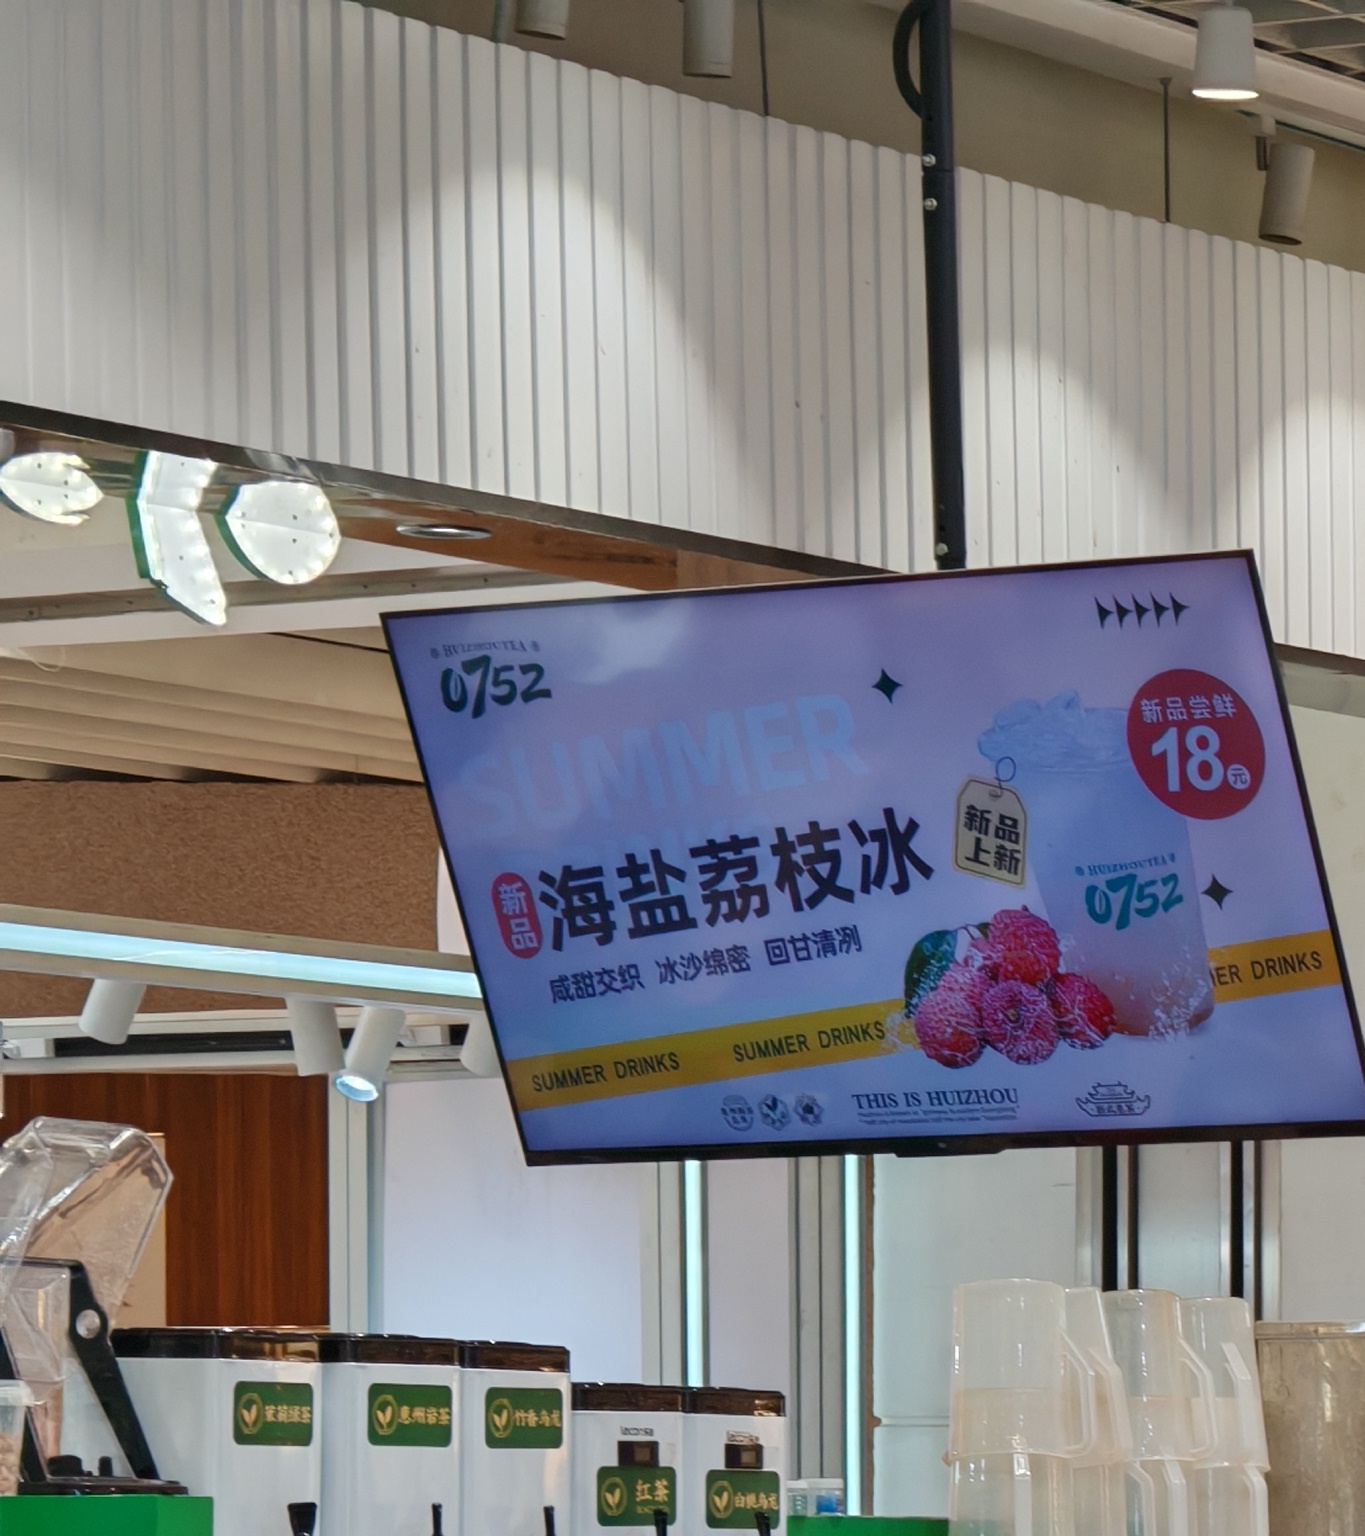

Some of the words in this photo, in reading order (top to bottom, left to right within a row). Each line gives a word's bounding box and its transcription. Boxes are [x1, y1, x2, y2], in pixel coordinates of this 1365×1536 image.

[440, 654, 552, 719] 0752
[1140, 693, 1236, 724] 新品尝鲜
[455, 692, 873, 840] SUMMER
[1151, 726, 1224, 792] 18
[965, 804, 1021, 845] 新品
[965, 837, 1021, 876] 上新
[538, 807, 934, 952] 海盐荔枝冰
[497, 881, 539, 951] 新品
[1084, 873, 1184, 930] 0752
[550, 964, 645, 1004] 咸甜交织
[657, 944, 751, 985] 冰沙绵密
[766, 924, 862, 966] 回甘清冽
[1251, 950, 1323, 980] DRINKS
[733, 1034, 809, 1063] SUMMER
[818, 1020, 885, 1049] DRINKS
[532, 1063, 607, 1092] SUMMER
[614, 1052, 680, 1080] DRINKS
[851, 1093, 899, 1109] THIS
[903, 1091, 922, 1108] IS
[926, 1088, 1019, 1107] HUIZHOU
[635, 1478, 669, 1503] 红茶
